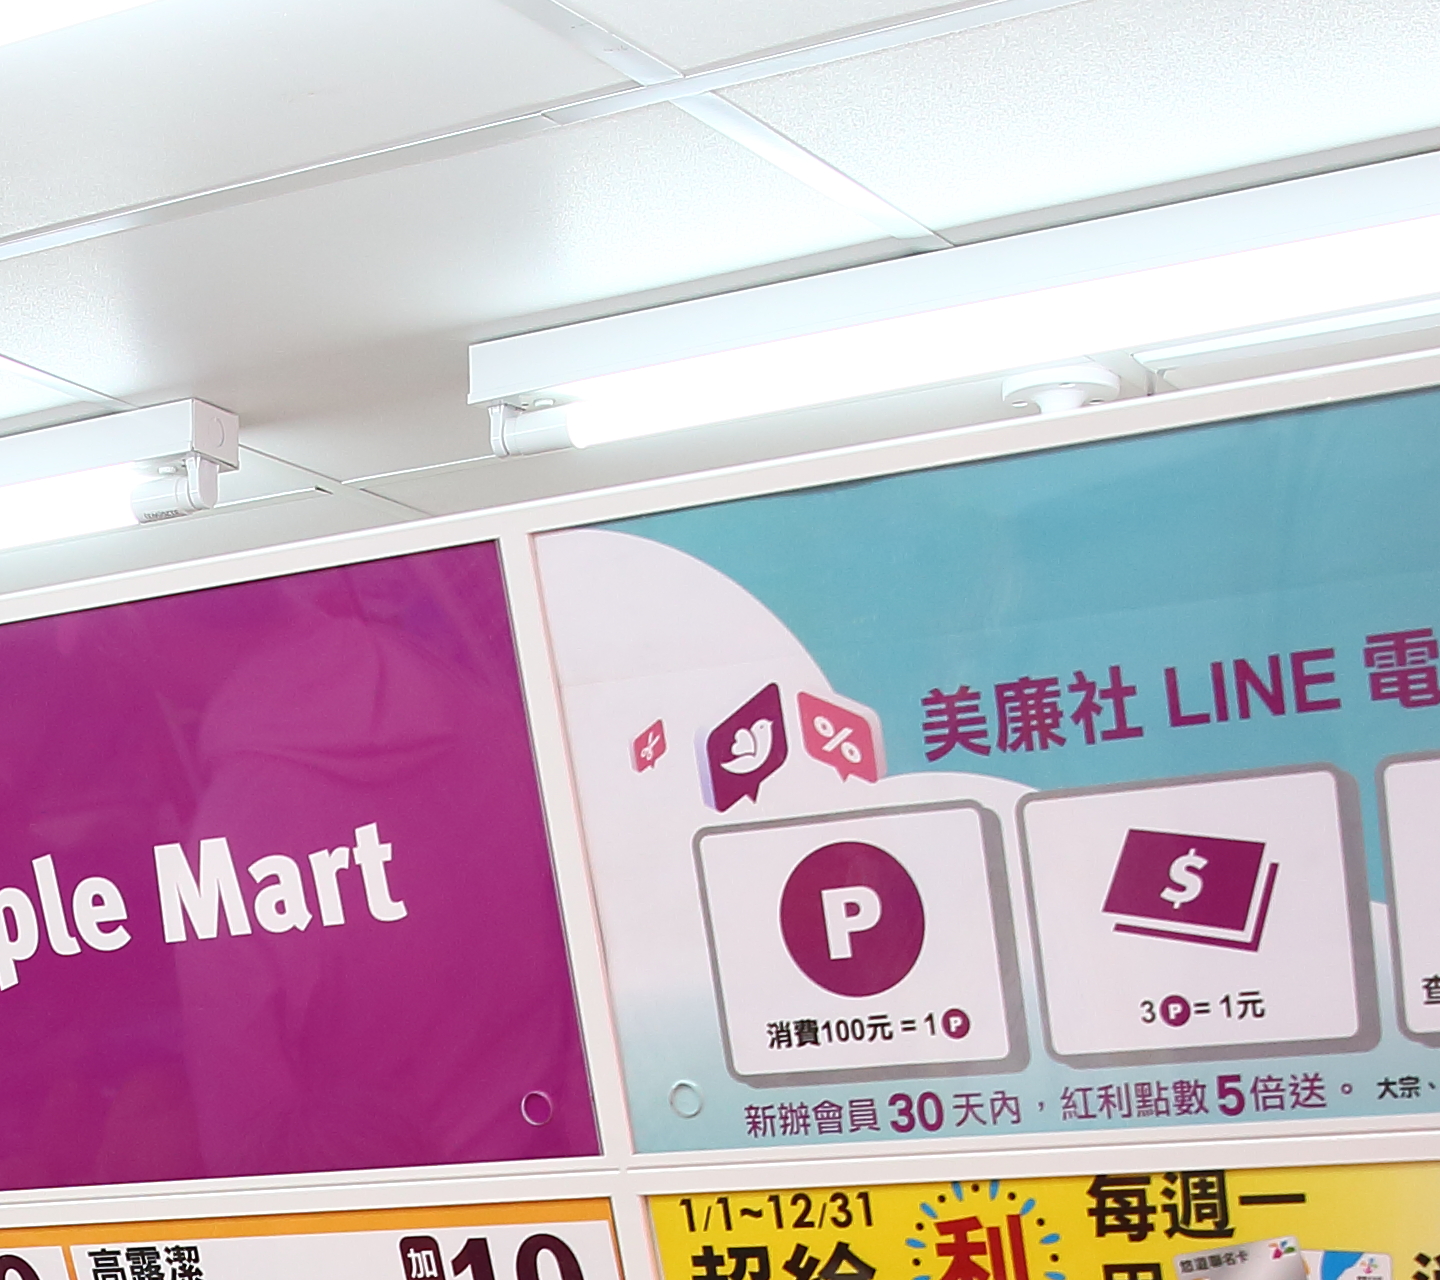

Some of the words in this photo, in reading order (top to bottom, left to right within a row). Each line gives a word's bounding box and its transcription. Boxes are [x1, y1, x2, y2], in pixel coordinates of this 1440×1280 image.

[919, 667, 1142, 764] 美廉社
[1165, 647, 1341, 730] LINE
[154, 823, 407, 946] Mart
[678, 1192, 875, 1235] 1/1~12/31
[1086, 1168, 1307, 1243] 每週一
